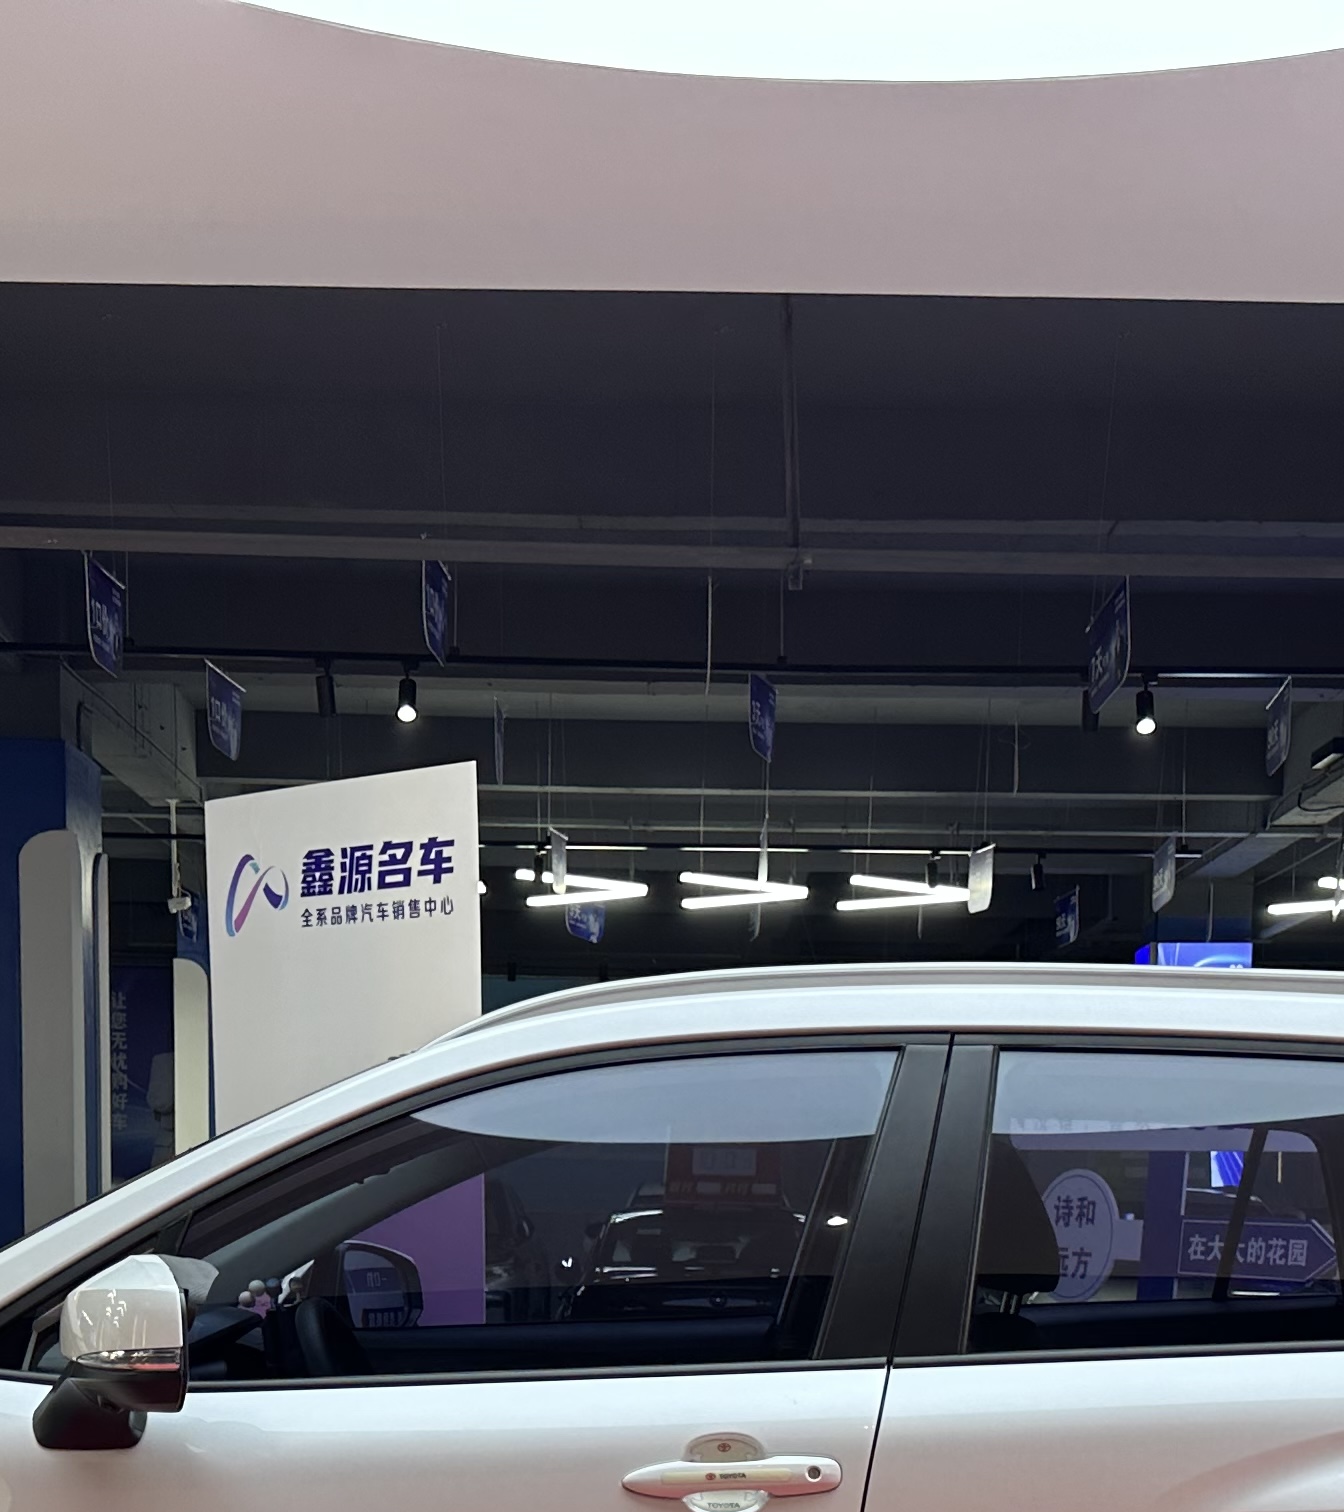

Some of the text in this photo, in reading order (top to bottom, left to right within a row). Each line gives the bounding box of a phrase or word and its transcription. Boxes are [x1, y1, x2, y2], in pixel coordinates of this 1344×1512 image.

[300, 837, 455, 897] 鑫源名车
[300, 896, 454, 928] 全系品牌汽车销售中心
[1054, 1195, 1096, 1228] 诗和
[719, 1472, 747, 1480] TOYOTA
[707, 1501, 741, 1509] TOYOTA
